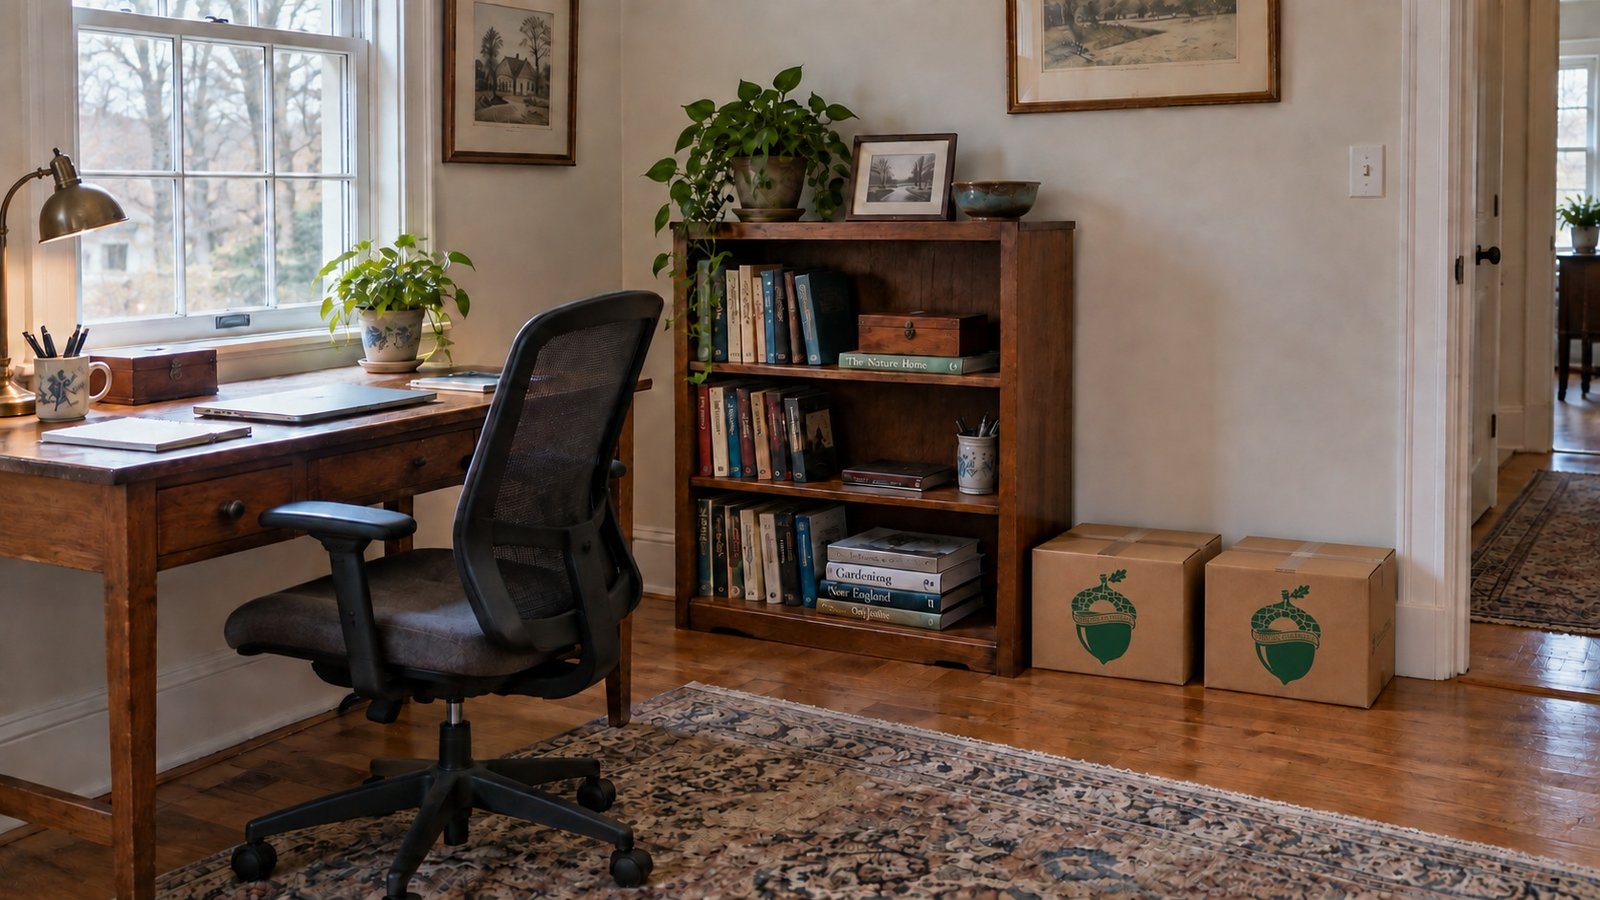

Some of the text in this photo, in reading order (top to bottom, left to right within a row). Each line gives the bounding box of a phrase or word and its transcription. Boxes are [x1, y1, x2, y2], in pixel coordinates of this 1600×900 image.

[846, 357, 928, 369] The Nature Home
